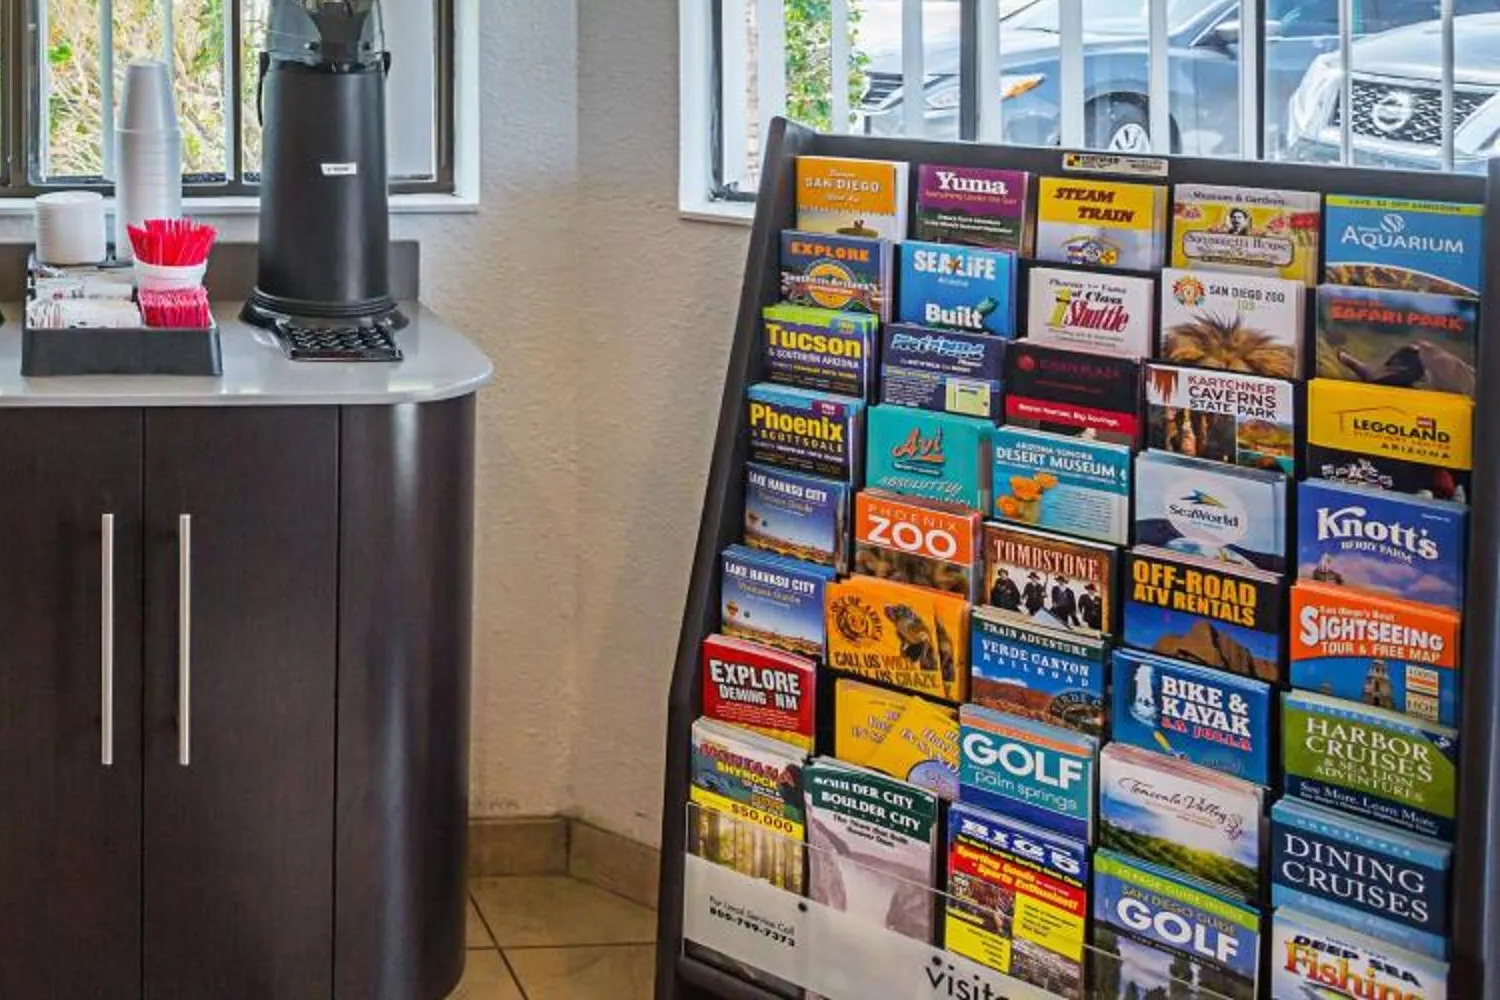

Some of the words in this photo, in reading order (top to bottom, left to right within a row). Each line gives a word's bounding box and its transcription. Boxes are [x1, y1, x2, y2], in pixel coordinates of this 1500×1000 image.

[804, 177, 832, 189] SAN
[836, 178, 881, 193] DIEGO
[935, 171, 1009, 195] Yuma
[1054, 187, 1116, 204] STEAM
[1077, 206, 1135, 223] TRAIN
[788, 241, 870, 262] EXPLORE
[1208, 284, 1229, 297] SAN
[1231, 286, 1263, 301] DIEGO
[924, 302, 984, 329] Built
[1068, 299, 1130, 333] Shuttle
[765, 323, 861, 359] Tucson
[1187, 375, 1277, 395] KARTCHNER
[1188, 385, 1277, 409] CAVERNS
[750, 403, 844, 443] Phoenix
[1189, 399, 1234, 413] STATE
[1237, 404, 1277, 420] PARK
[761, 429, 844, 454] SCOTTSDALE
[1353, 417, 1451, 444] LEGOLAND
[996, 446, 1046, 466] DESERT
[1050, 455, 1116, 478] MUSEUM
[1380, 442, 1451, 460] ARIZONA
[867, 503, 959, 532] PHOENIX
[1169, 504, 1240, 529] SeaWorld
[1316, 505, 1440, 561] Knott's
[867, 513, 959, 560] ZOO
[993, 538, 1100, 582] TOMBSTONE
[725, 561, 749, 579] LAKE
[791, 579, 816, 595] CITY
[1133, 559, 1258, 608] OFF-ROAD
[1133, 582, 1170, 606] ATV
[1173, 590, 1256, 628] RENTALS
[983, 622, 1017, 639] TRAIN
[1019, 631, 1089, 657] ADVENTURE
[1300, 605, 1444, 651] SIGHTSEEING
[981, 639, 1029, 661] VERDE
[1031, 653, 1090, 678] CANYON
[1321, 640, 1354, 656] TOUR
[1359, 643, 1368, 656] &
[1374, 643, 1406, 660] FREE
[1409, 646, 1442, 664] MAP
[709, 658, 801, 697] EXPLORE
[774, 692, 799, 711] NM
[1161, 675, 1223, 709] BIKE
[1228, 693, 1249, 716] &
[1161, 695, 1252, 738] KAYAK
[1306, 717, 1431, 765] HARBOR
[963, 733, 1083, 790] GOLF
[1305, 735, 1434, 784] CRUISES
[883, 790, 915, 809] CITY
[1017, 781, 1079, 811] springs
[1118, 777, 1182, 806] Temecula
[821, 791, 887, 819] BOULDER
[889, 811, 922, 832] CITY
[1284, 833, 1427, 895] DINING
[1281, 860, 1430, 924] CRUISES
[1117, 897, 1240, 963] GOLF
[1294, 934, 1361, 961] DEEP
[1368, 958, 1423, 988] SEA
[925, 963, 1010, 1000] visit
